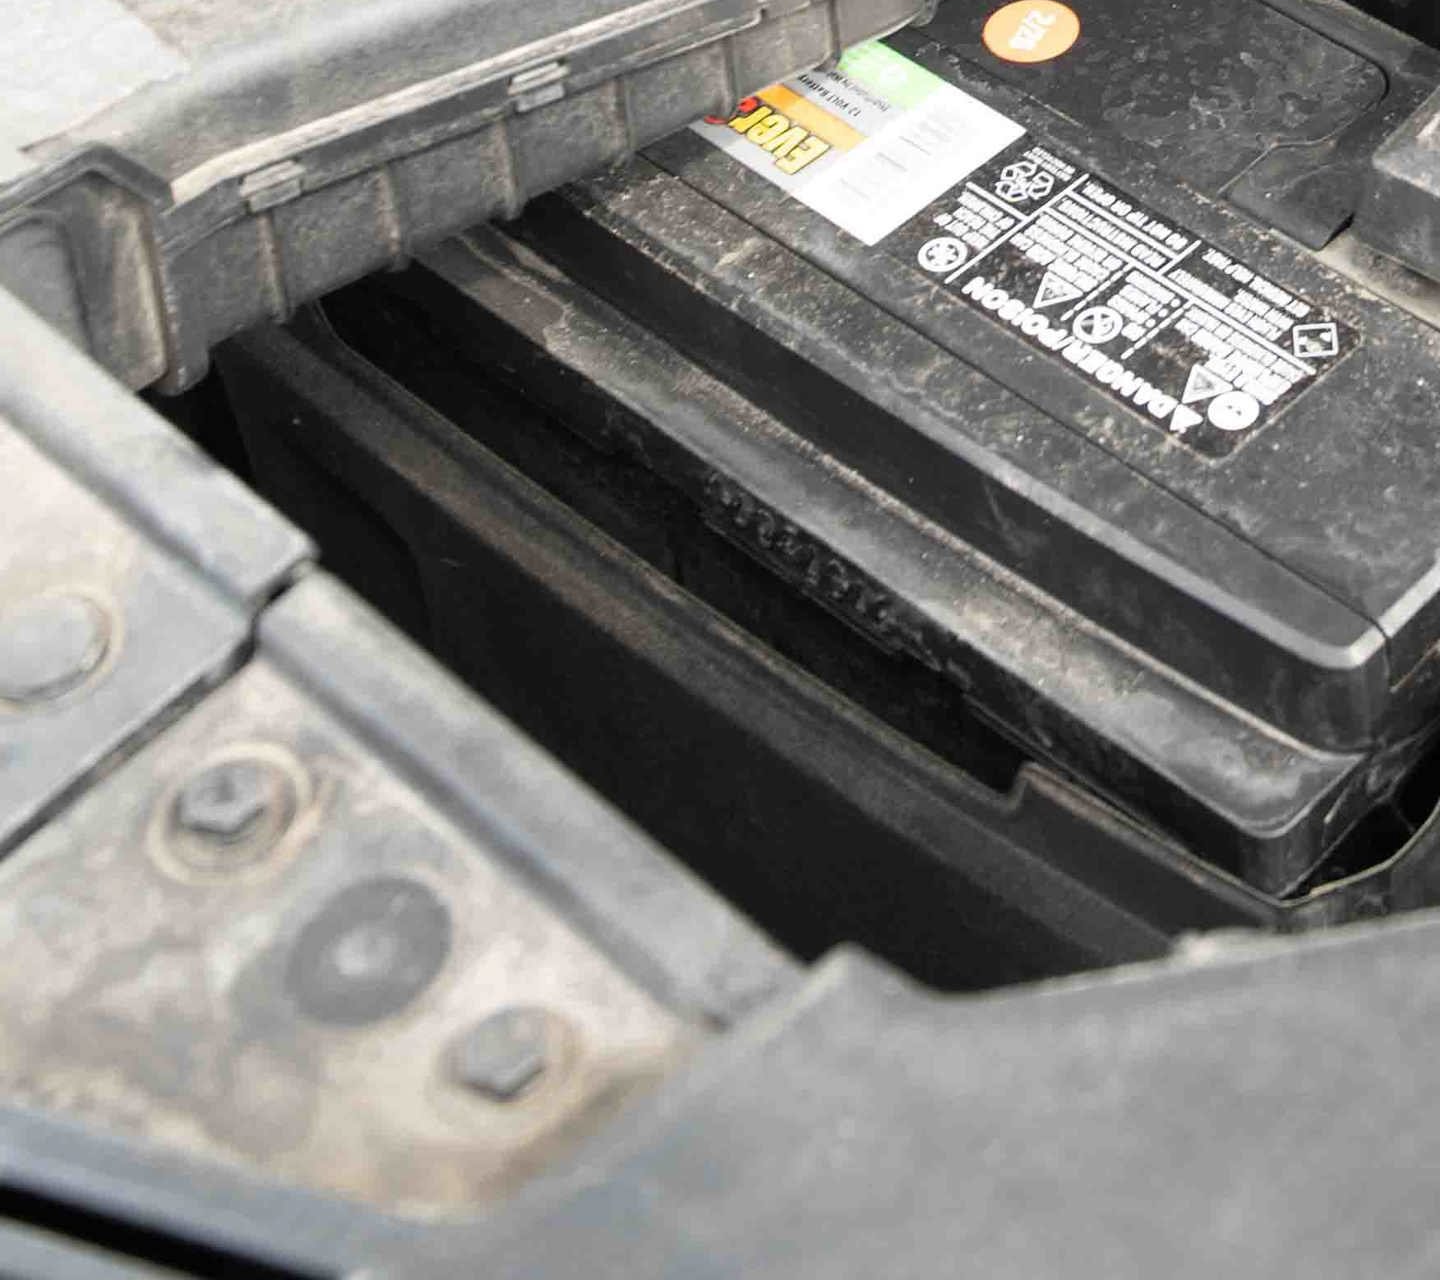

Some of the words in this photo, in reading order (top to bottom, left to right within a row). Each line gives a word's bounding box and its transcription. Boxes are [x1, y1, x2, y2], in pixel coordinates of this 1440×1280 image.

[825, 92, 852, 110] VOLT
[845, 105, 863, 118] 12
[1106, 199, 1134, 217] OR
[1122, 209, 1152, 227] TIP
[1140, 219, 1173, 240] NOT
[1161, 232, 1190, 250] DO
[956, 274, 1180, 420] DANGER/POISON
